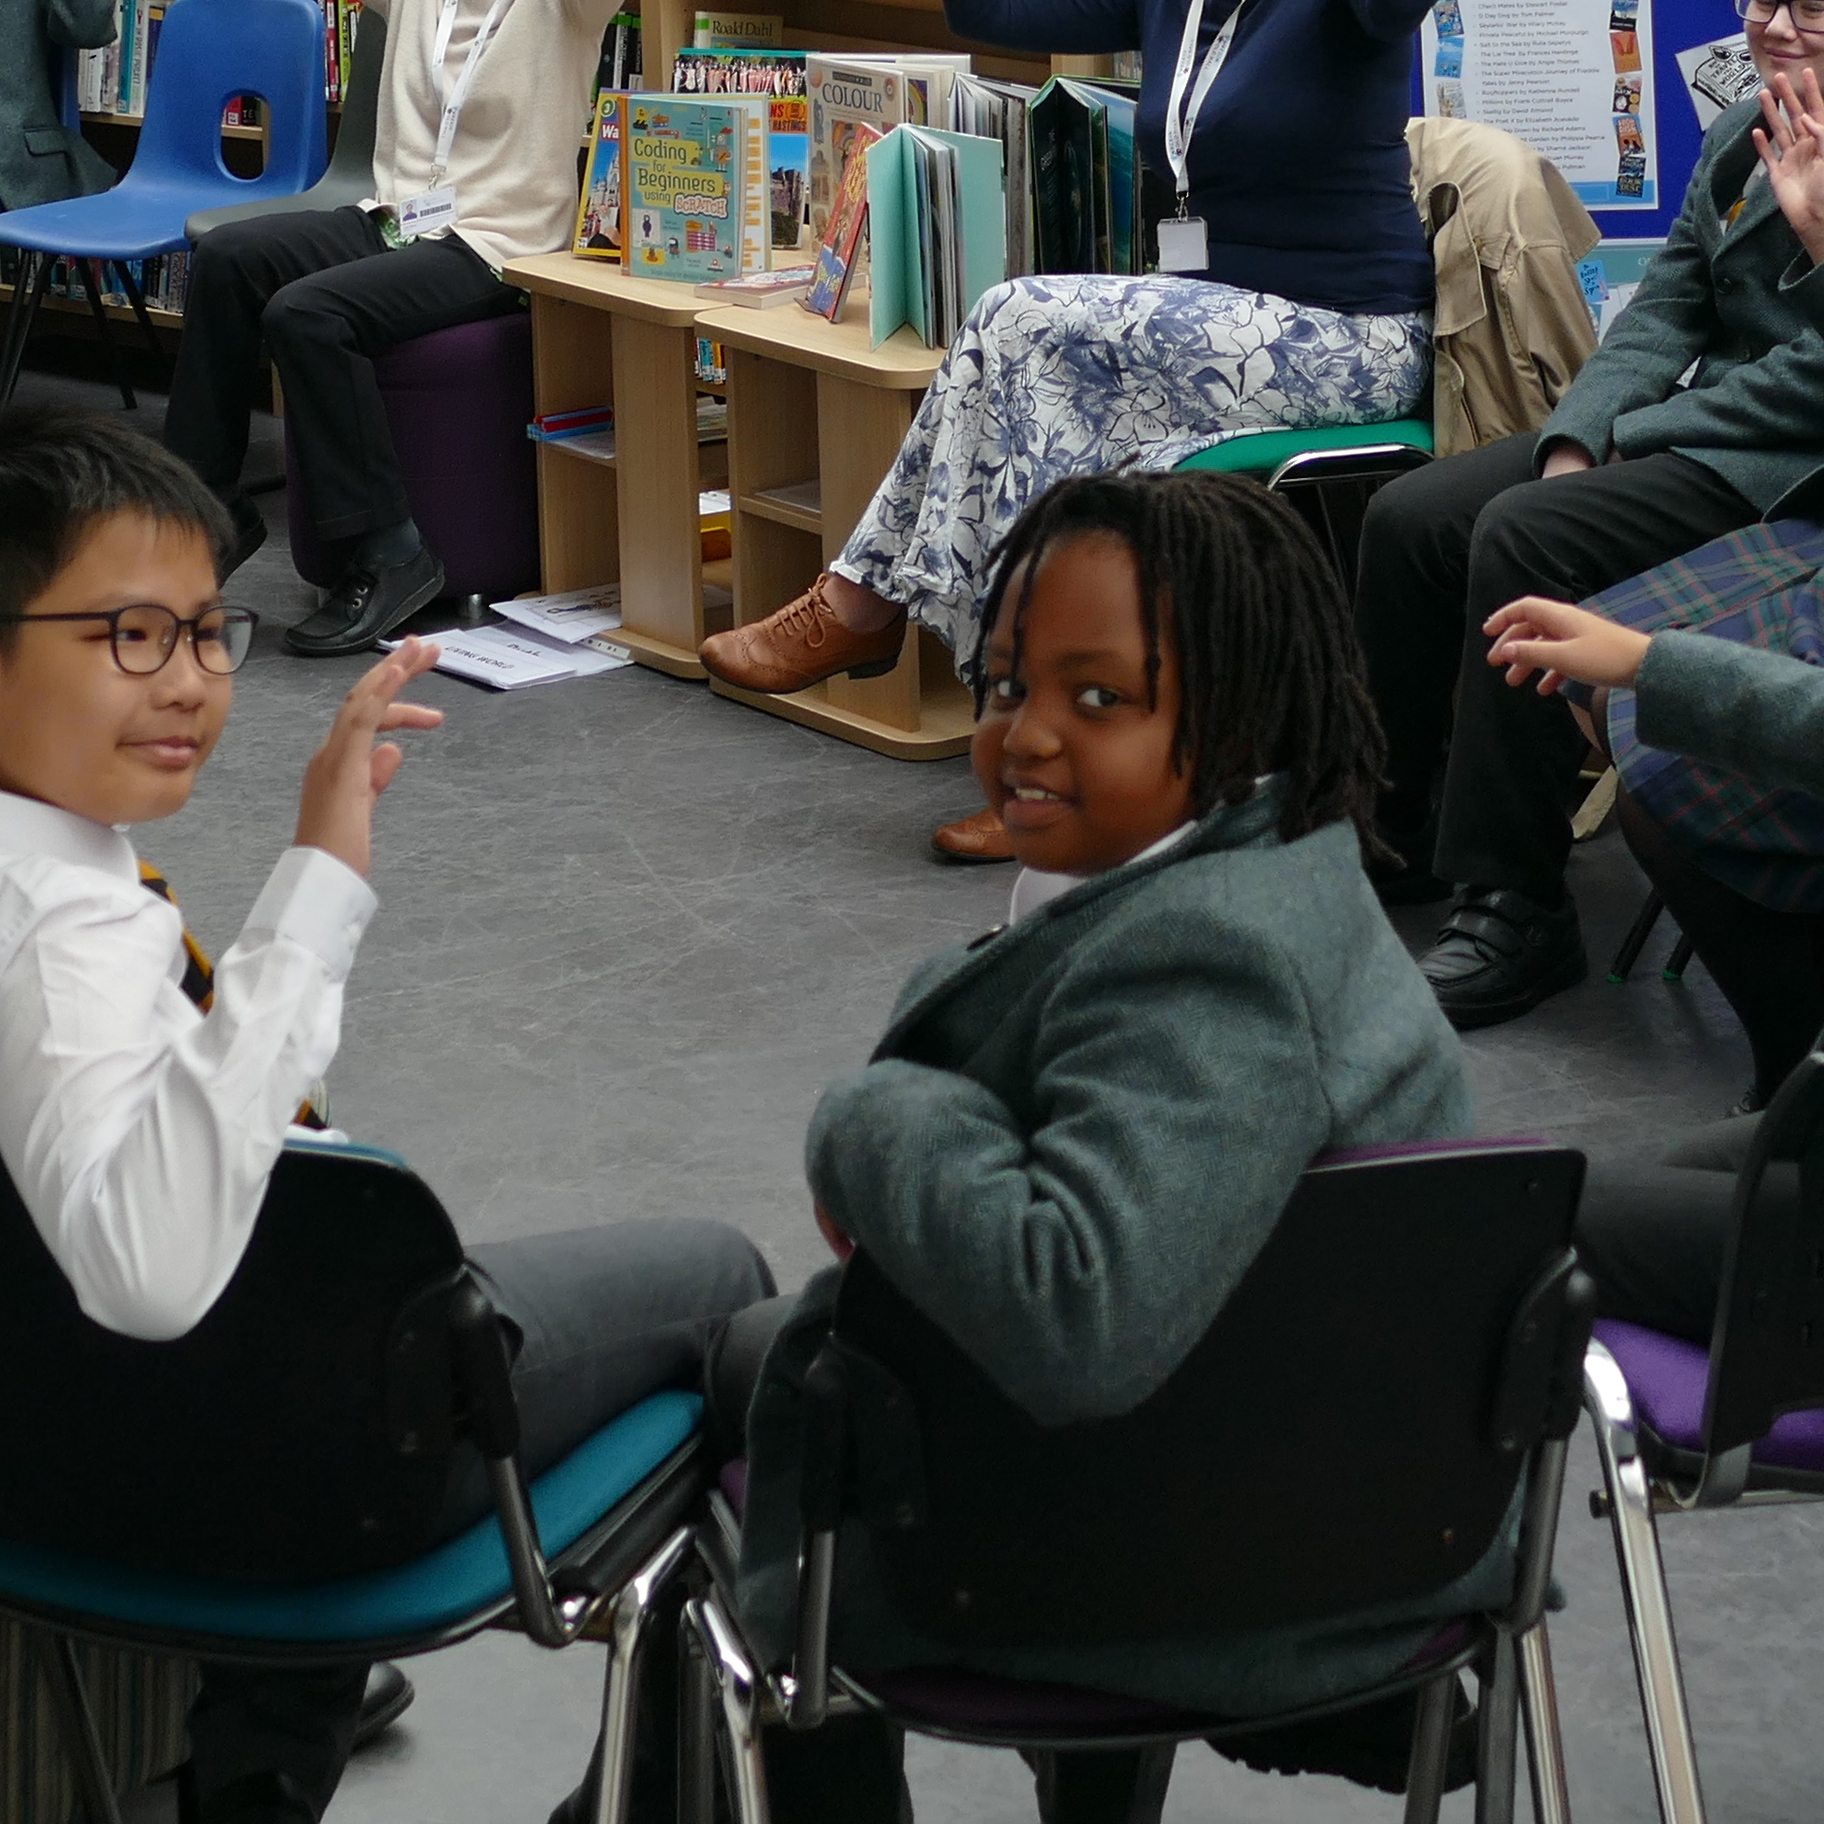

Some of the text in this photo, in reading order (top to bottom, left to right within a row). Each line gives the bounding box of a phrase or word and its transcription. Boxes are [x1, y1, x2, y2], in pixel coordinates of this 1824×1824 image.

[712, 20, 773, 38] Roald Dahl
[822, 83, 884, 114] COLOUR
[634, 137, 687, 165] Coding
[653, 160, 667, 172] for
[638, 168, 716, 193] Beginners
[644, 192, 727, 217] using SCRATCH
